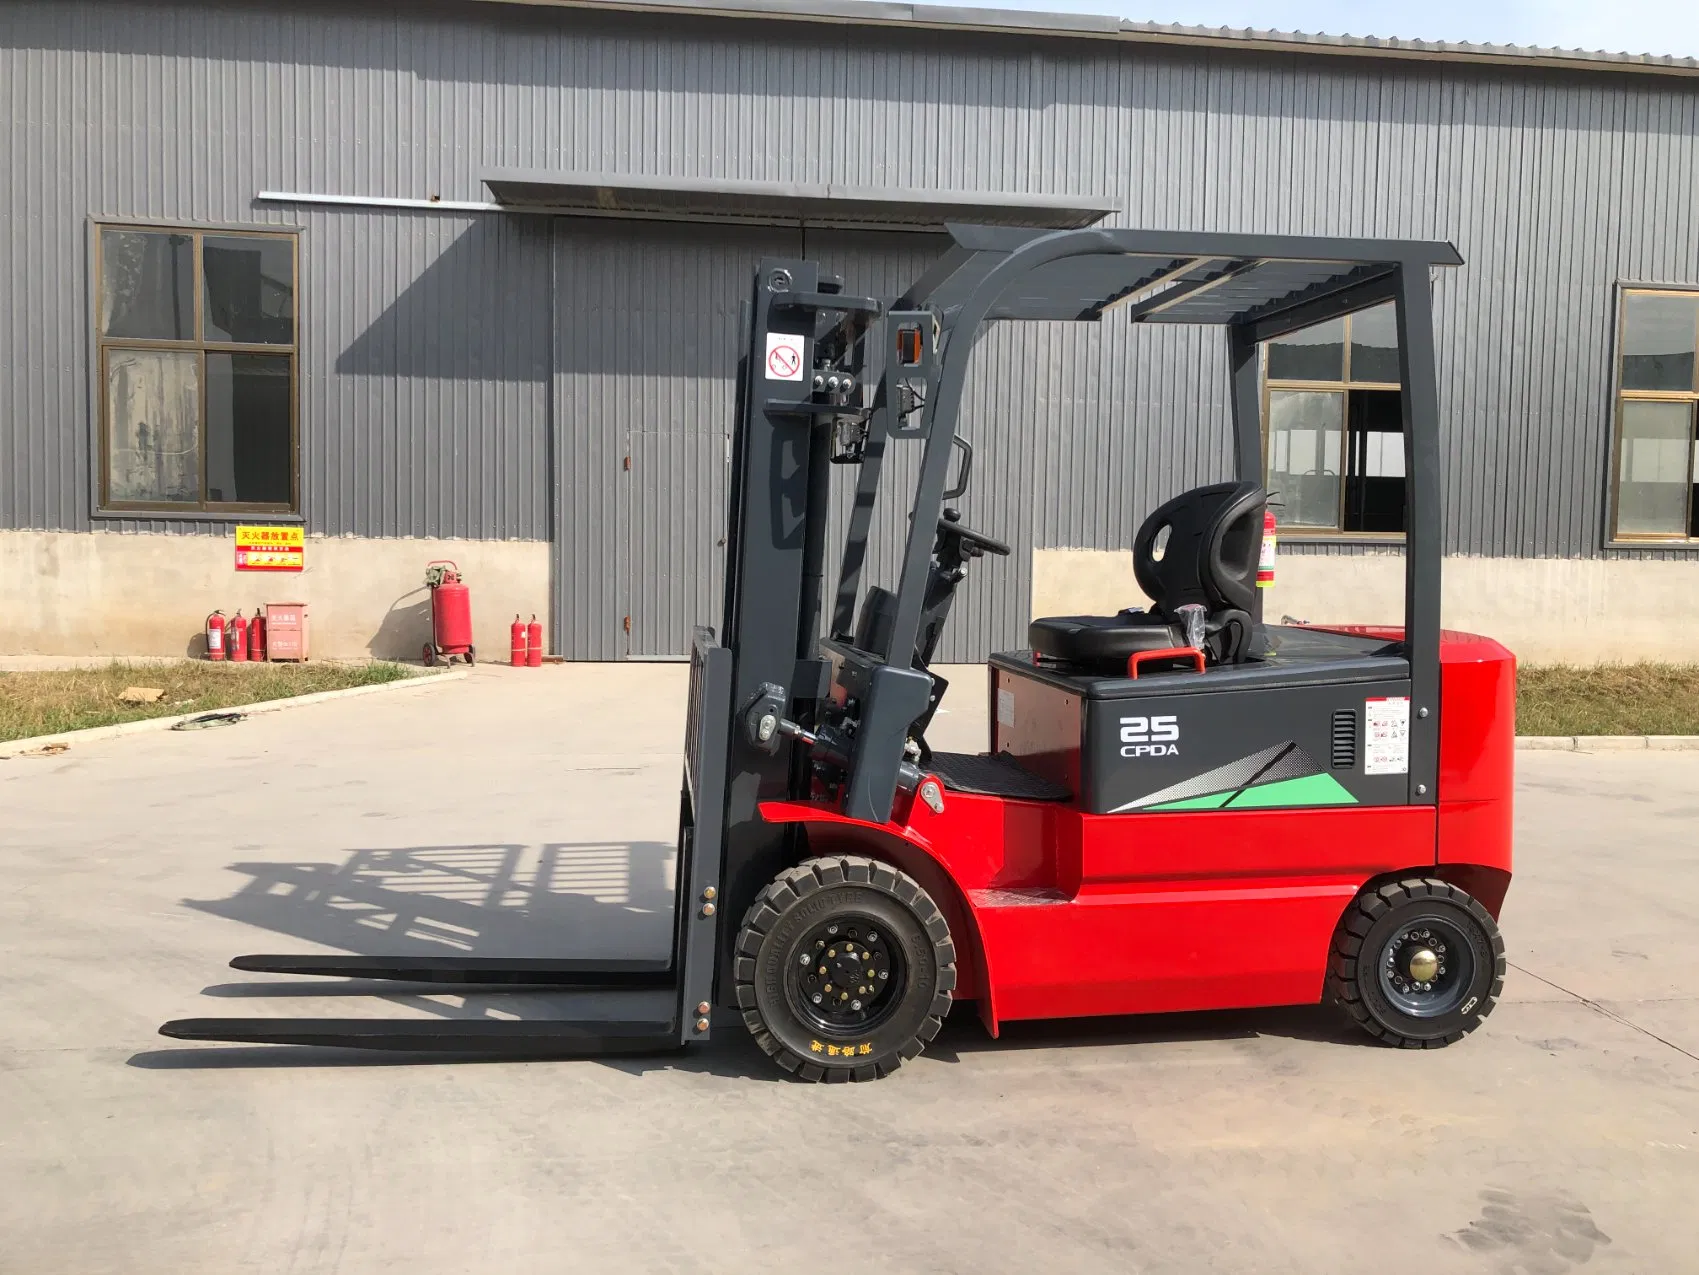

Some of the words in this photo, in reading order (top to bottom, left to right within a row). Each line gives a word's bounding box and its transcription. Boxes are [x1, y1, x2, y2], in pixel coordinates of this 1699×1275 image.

[241, 531, 299, 541] 灭火器放置点
[1120, 715, 1179, 743] 25
[1120, 744, 1179, 757] CPDA
[829, 891, 862, 903] TYRE
